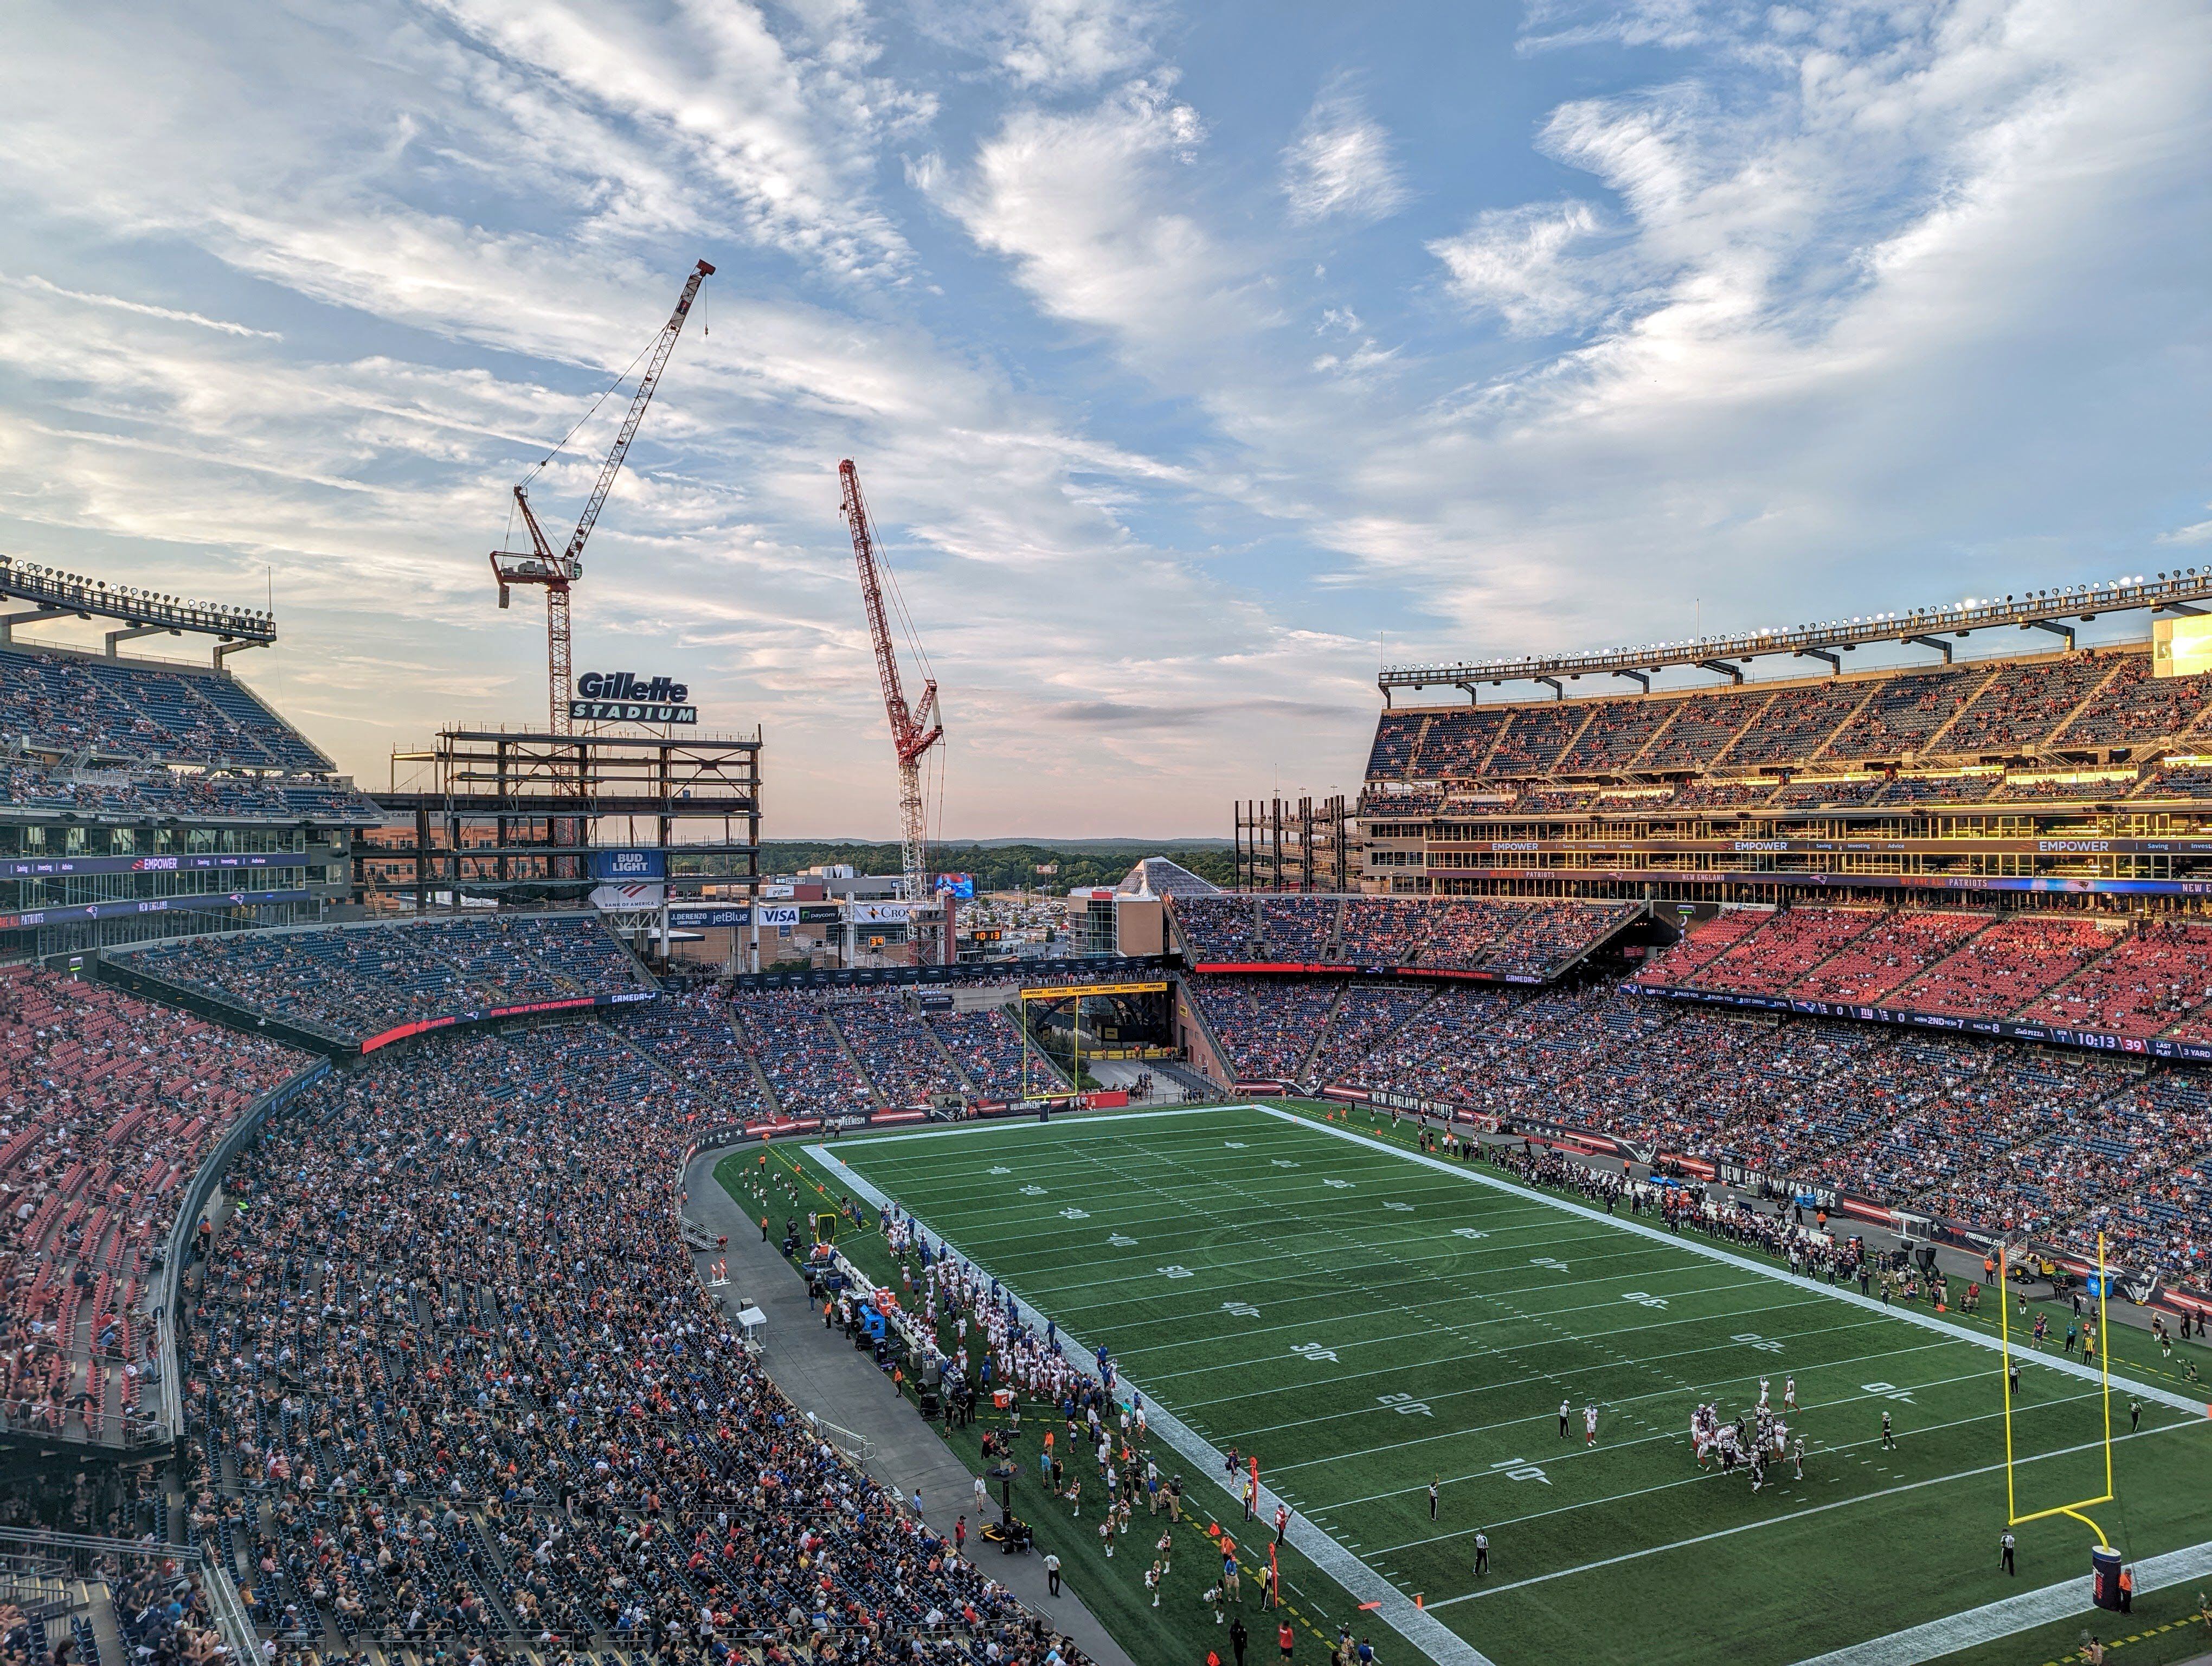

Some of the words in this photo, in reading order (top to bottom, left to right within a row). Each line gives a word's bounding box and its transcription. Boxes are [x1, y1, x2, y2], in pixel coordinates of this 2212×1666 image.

[577, 672, 688, 703] Gillette
[573, 704, 693, 721] STADIUM
[1735, 842, 1787, 850] EMPOWER
[2040, 842, 2109, 851] EMPOWER
[618, 854, 643, 862] BUD
[144, 858, 177, 870] EMPOWER
[613, 862, 648, 872] LIGHT
[1949, 879, 1988, 887] PATRIOTS
[2183, 884, 2202, 893] NEW
[139, 902, 147, 912] NEW
[21, 913, 44, 925] PATRIOTS
[712, 912, 748, 925] jetBlue
[763, 911, 796, 922] VISA
[977, 932, 1000, 940] 10:13
[871, 938, 884, 946] 39
[1837, 1007, 1843, 1015] 0
[1898, 1013, 1905, 1023] 0
[1928, 1017, 1944, 1026] 2ND
[1957, 1020, 1964, 1029] 7
[1992, 1024, 1999, 1034] 8
[2079, 1033, 2115, 1048] 10:13
[2125, 1040, 2142, 1051] 39
[1372, 1091, 1387, 1104] NEW
[1390, 1094, 1418, 1110] ENGLAND
[1721, 1164, 1741, 1182] NEW
[1019, 1186, 1048, 1195] 20
[1384, 1202, 1414, 1212] 40
[1059, 1208, 1091, 1219] 30
[1451, 1228, 1489, 1239] 50
[1107, 1235, 1139, 1247] 40
[1529, 1258, 1568, 1272] 40
[1156, 1265, 1194, 1278] 50
[1622, 1292, 1668, 1307] 30
[1220, 1302, 1259, 1316] 40
[1729, 1333, 1785, 1351] 20
[1290, 1342, 1338, 1361] 30
[1861, 1382, 1914, 1399] 10
[1001, 1396, 1007, 1405] G
[1376, 1393, 1431, 1415] 20
[1490, 1458, 1547, 1482] 10
